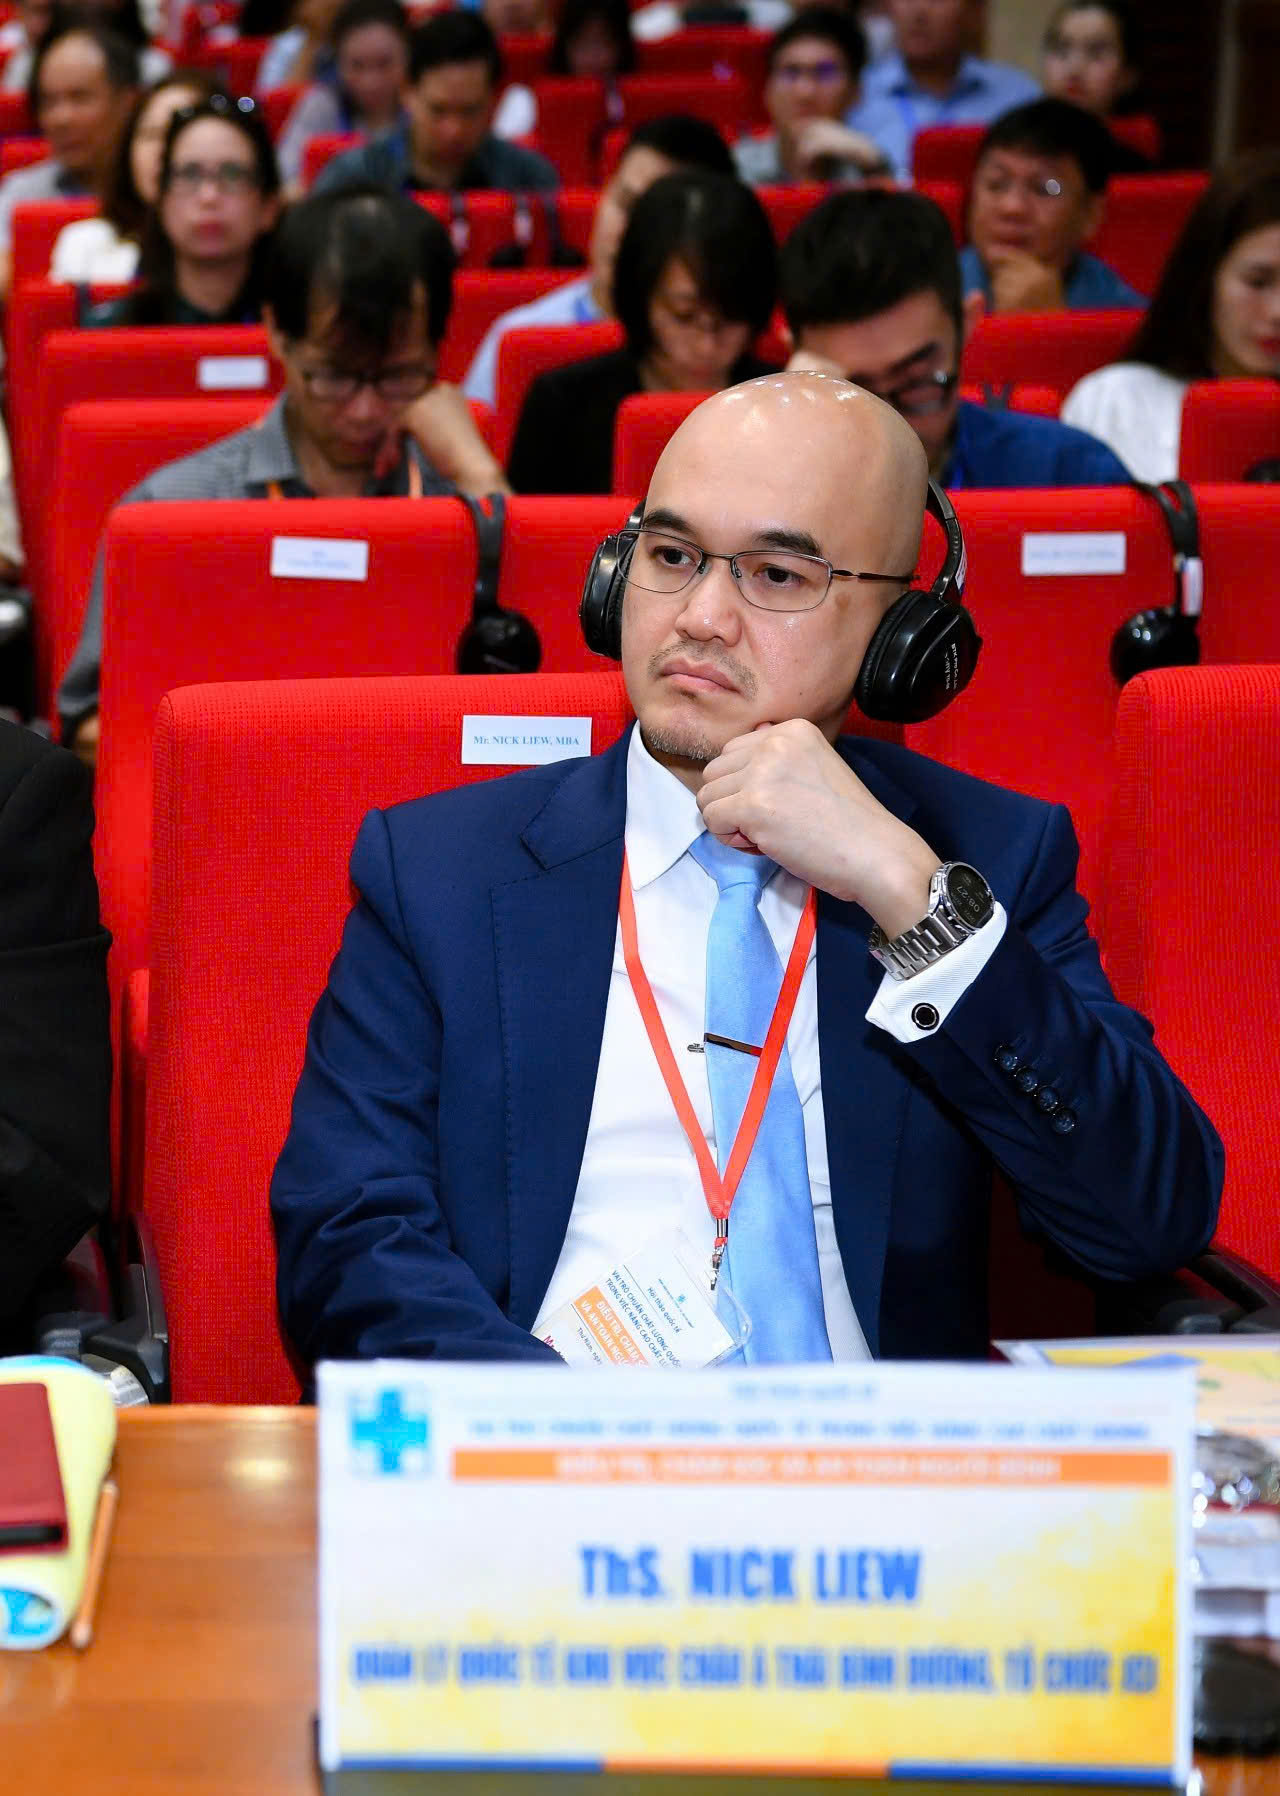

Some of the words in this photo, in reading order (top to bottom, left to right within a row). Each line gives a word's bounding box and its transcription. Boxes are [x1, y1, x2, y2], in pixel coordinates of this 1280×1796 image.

[473, 735, 490, 745] Mr.
[493, 735, 520, 745] NICK
[522, 736, 553, 746] LIEW,
[556, 736, 580, 745] MBA
[605, 1277, 622, 1300] TRONG
[639, 1329, 651, 1343] CAO
[690, 1547, 798, 1601] NICK
[814, 1548, 924, 1602] LIEW
